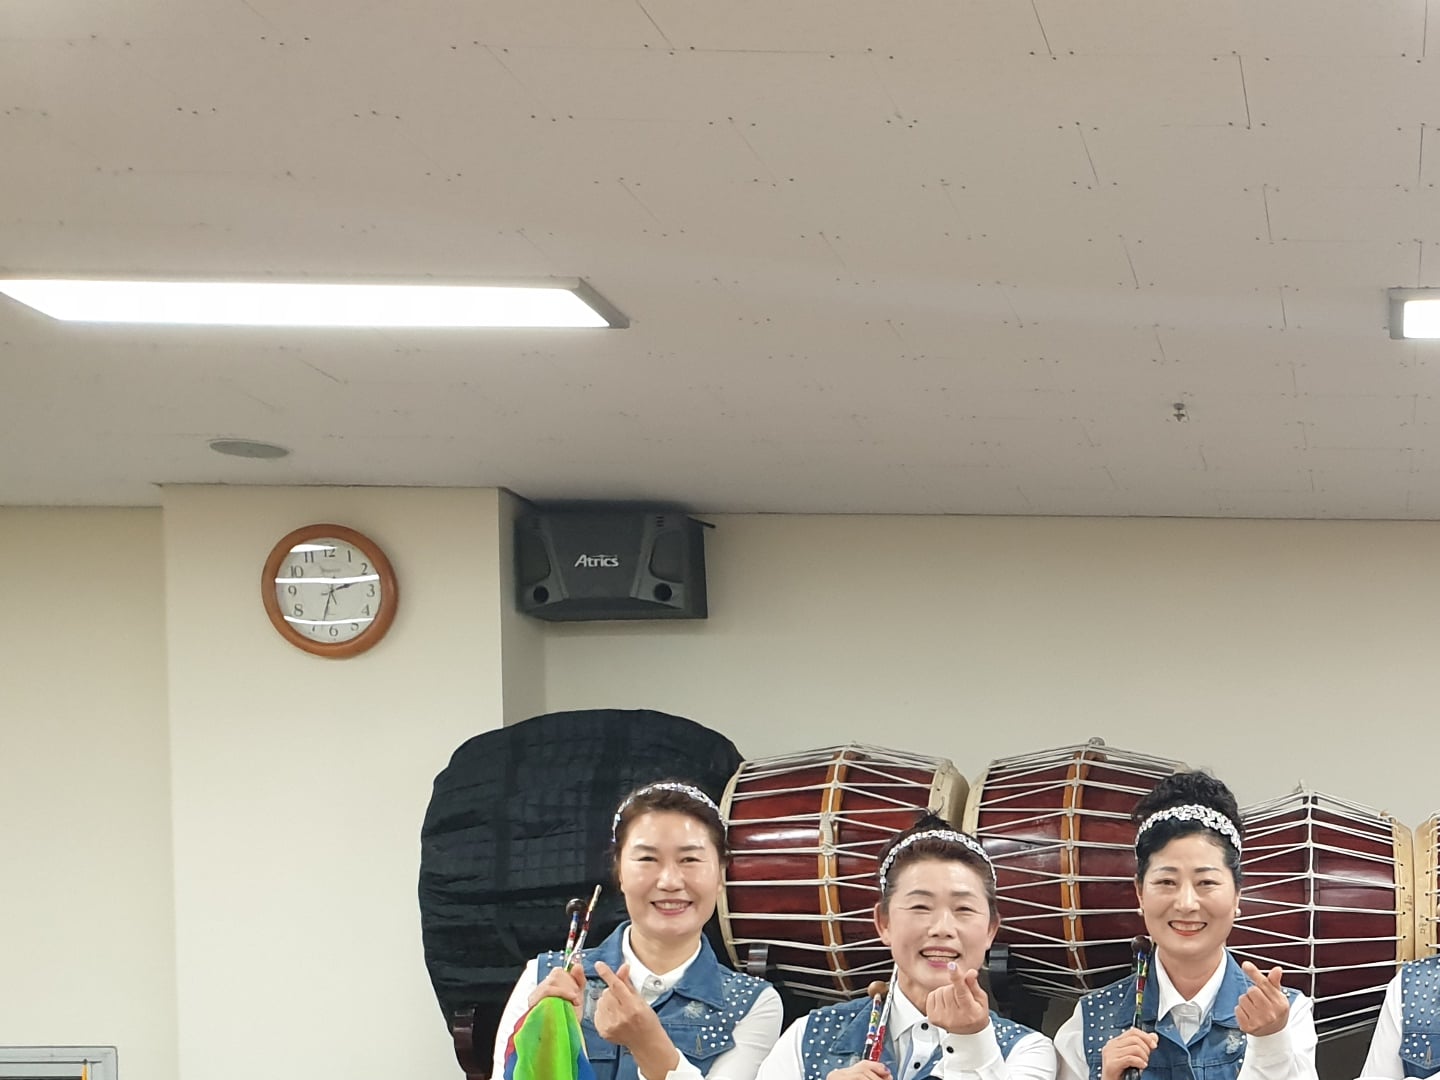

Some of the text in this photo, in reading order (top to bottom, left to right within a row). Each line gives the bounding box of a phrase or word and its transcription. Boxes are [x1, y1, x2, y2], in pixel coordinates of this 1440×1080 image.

[304, 551, 314, 563] 11
[347, 550, 352, 563] 1
[574, 554, 619, 568] Atrics
[290, 565, 304, 578] 10
[361, 562, 368, 575] 2
[288, 585, 297, 597] 9
[366, 584, 376, 598] 3
[293, 603, 304, 617] 8
[360, 604, 370, 616] 4
[329, 624, 338, 637] 6
